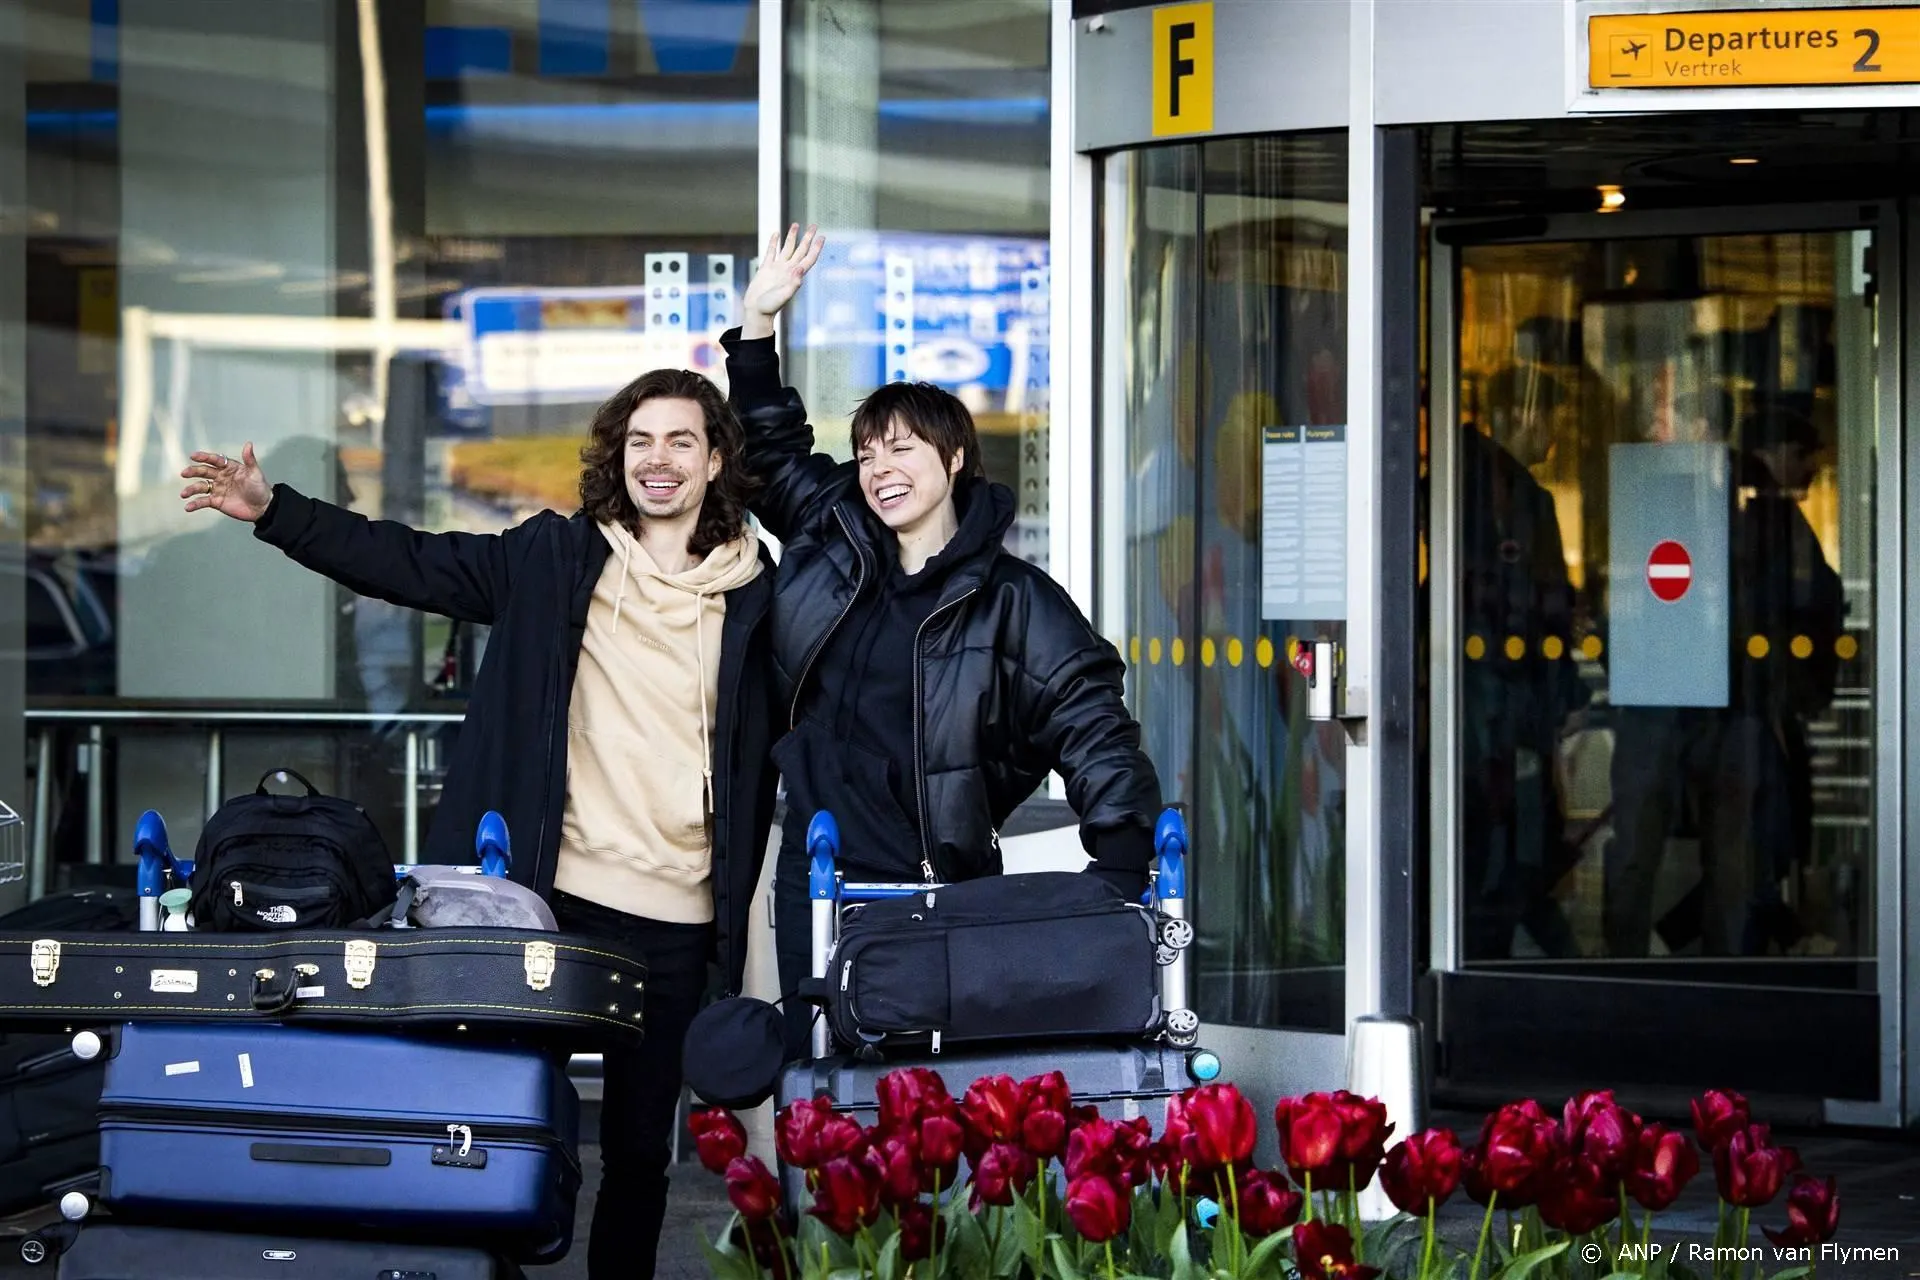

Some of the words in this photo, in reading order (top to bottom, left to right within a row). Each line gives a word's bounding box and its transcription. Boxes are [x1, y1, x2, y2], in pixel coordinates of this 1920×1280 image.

[1170, 22, 1195, 117] F
[1664, 59, 1742, 77] Vertrek
[1665, 28, 1839, 57] Departures
[1853, 28, 1881, 72] 2
